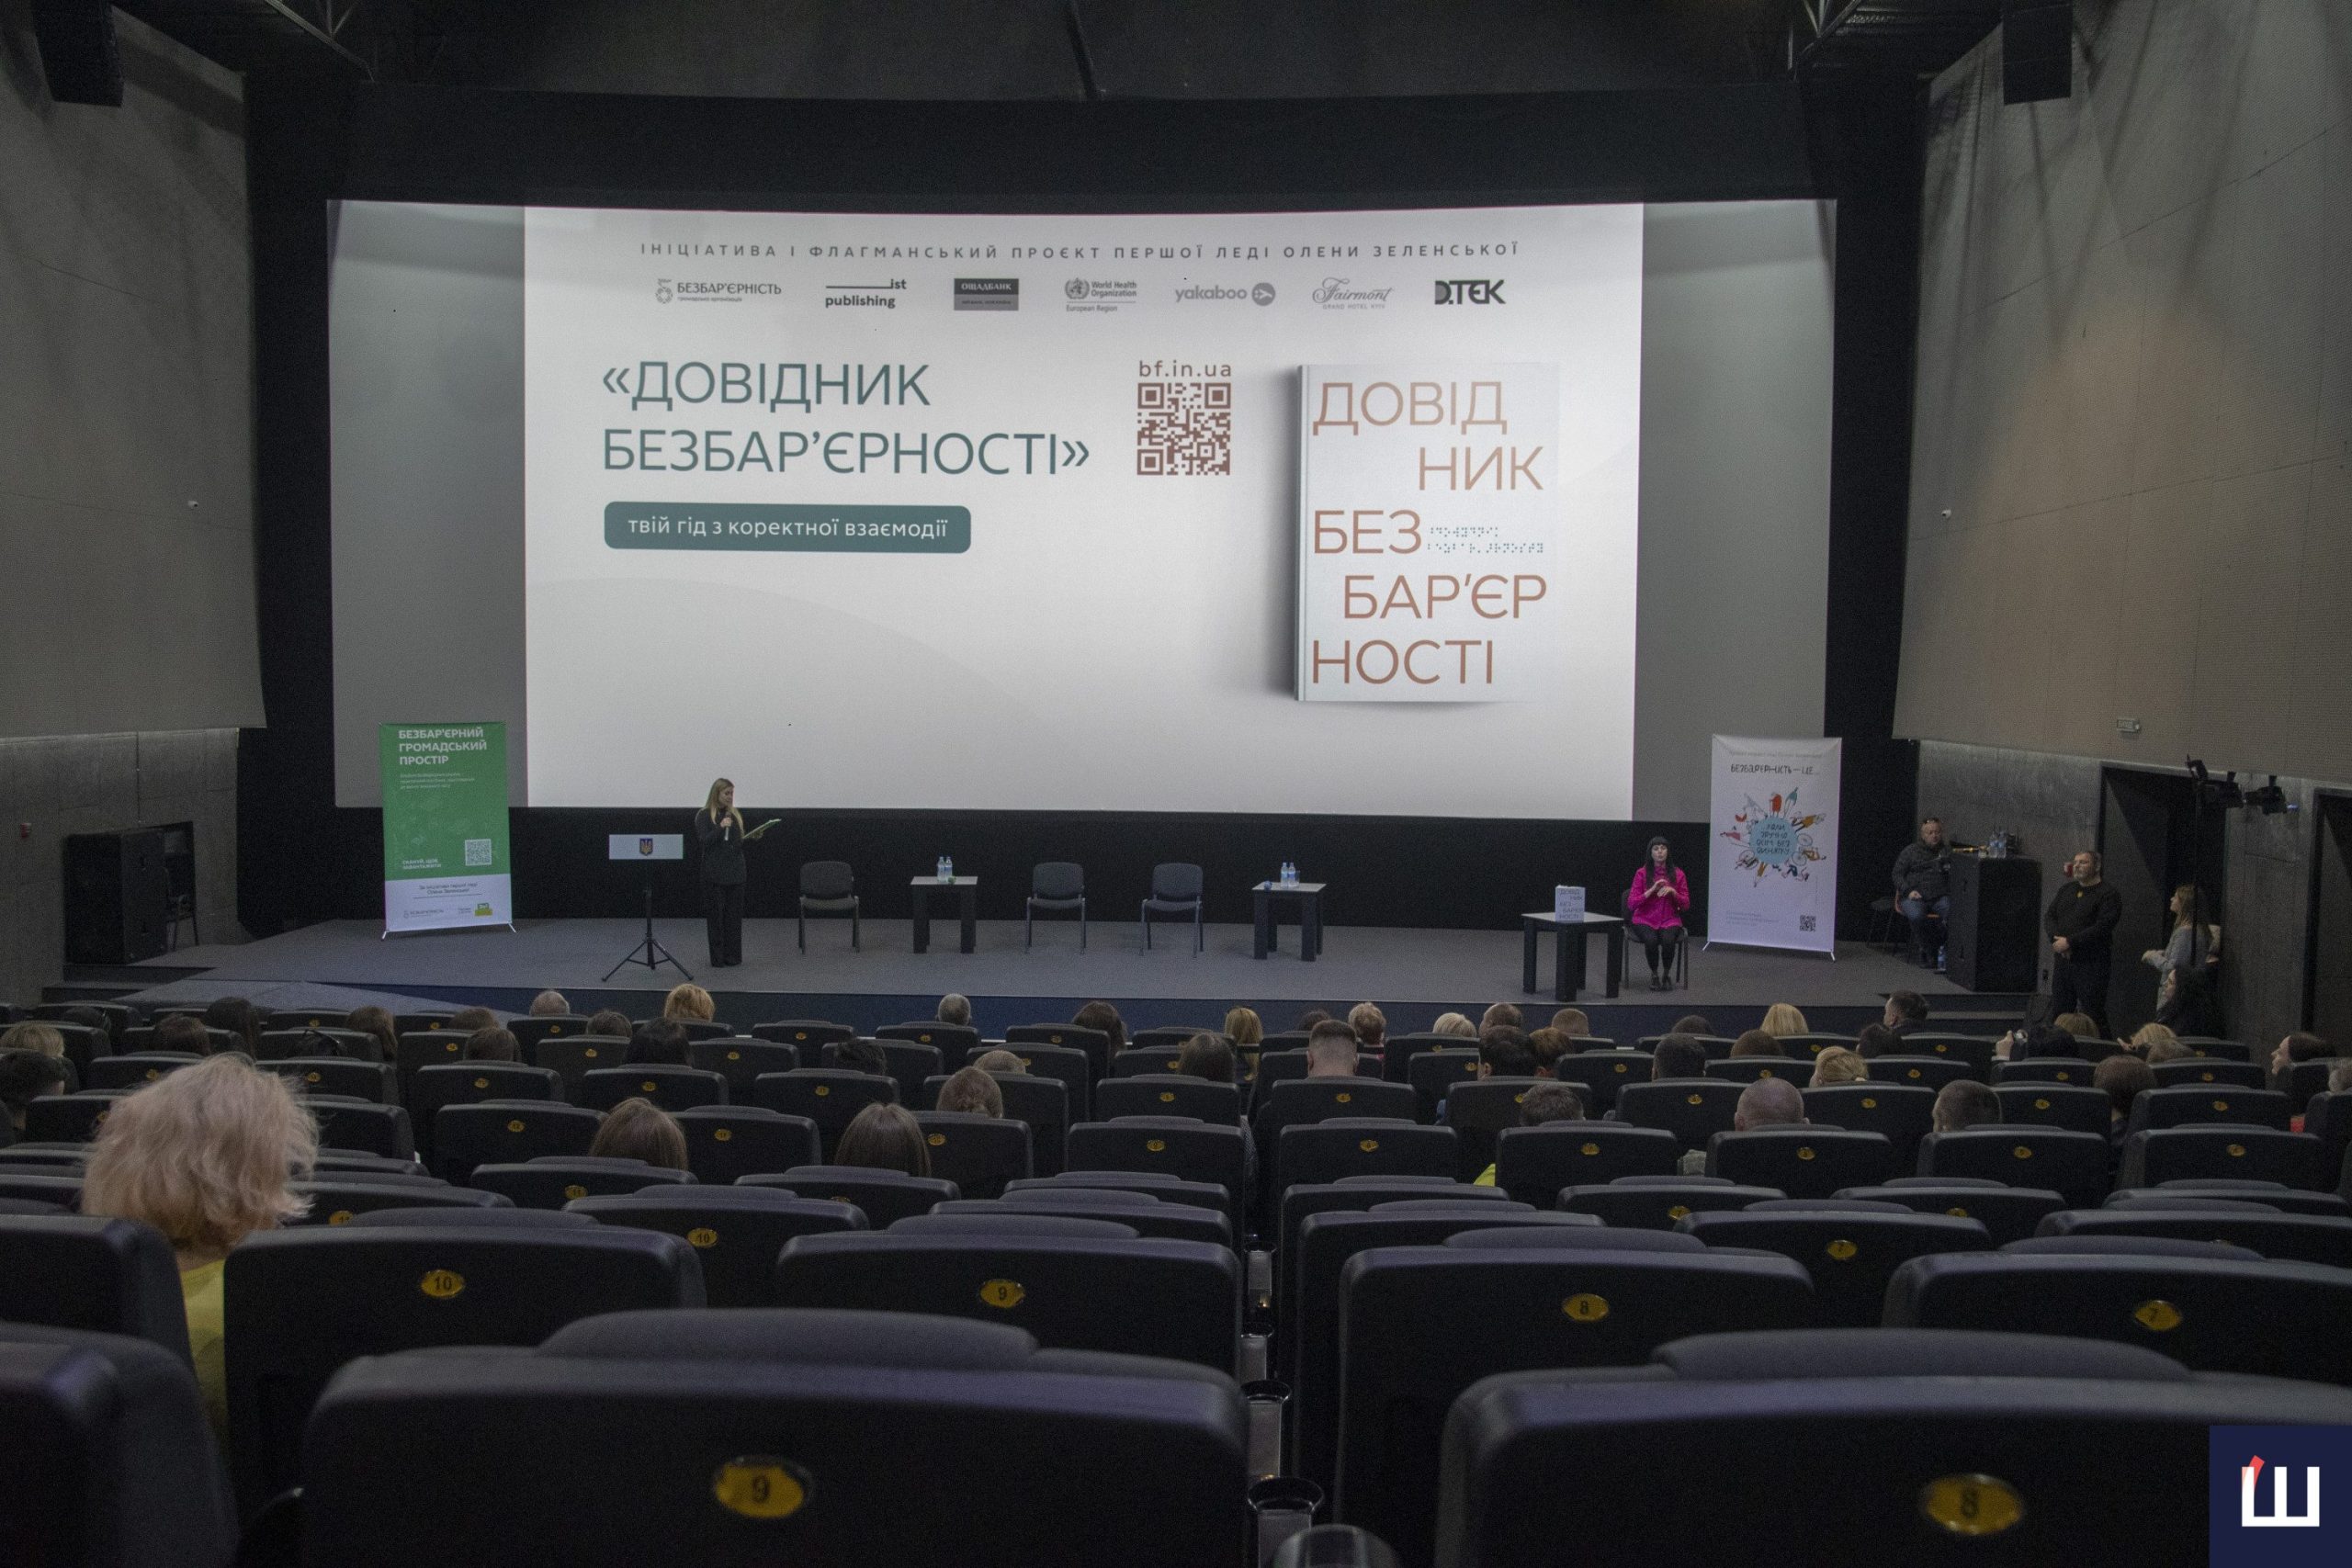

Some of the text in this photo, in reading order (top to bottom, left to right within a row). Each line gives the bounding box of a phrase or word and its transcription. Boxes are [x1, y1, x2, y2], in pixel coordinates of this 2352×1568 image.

[641, 242, 1519, 260] ІНІЦІАТИВА І ФЛАГМАНСЬКИЙ ПРОЄКТ ПЕРШОЇ ЛЕДІ ОЛЕНИ ЗЕЛЕНСЬКОЇ
[677, 282, 782, 295] БЕЗБАР'ЄРНІСТЬ
[1091, 289, 1137, 299] Organization
[1175, 285, 1248, 303] yakaboo
[1312, 277, 1393, 304] Fairmont
[825, 296, 896, 309] publishing
[1138, 360, 1232, 378] bf.in.ua
[603, 361, 931, 413] «ДОВІДНИК
[1312, 381, 1508, 436] ДОВІД
[1418, 446, 1544, 491] НИК
[628, 516, 948, 539] твій гід з коректної взаємодії
[1313, 509, 1422, 554] БЕЗ
[1312, 638, 1493, 684] НОСТІ
[399, 739, 487, 752] ГРОМАДСЬКИЙ
[400, 756, 449, 765] ПРОСТІР
[698, 1233, 710, 1243] 10
[435, 1276, 451, 1292] 10
[999, 1285, 1007, 1301] 9
[1579, 1301, 1589, 1314] 8
[2149, 1308, 2159, 1323] 7
[752, 1475, 770, 1503] 9
[1961, 1488, 1979, 1517] 8
